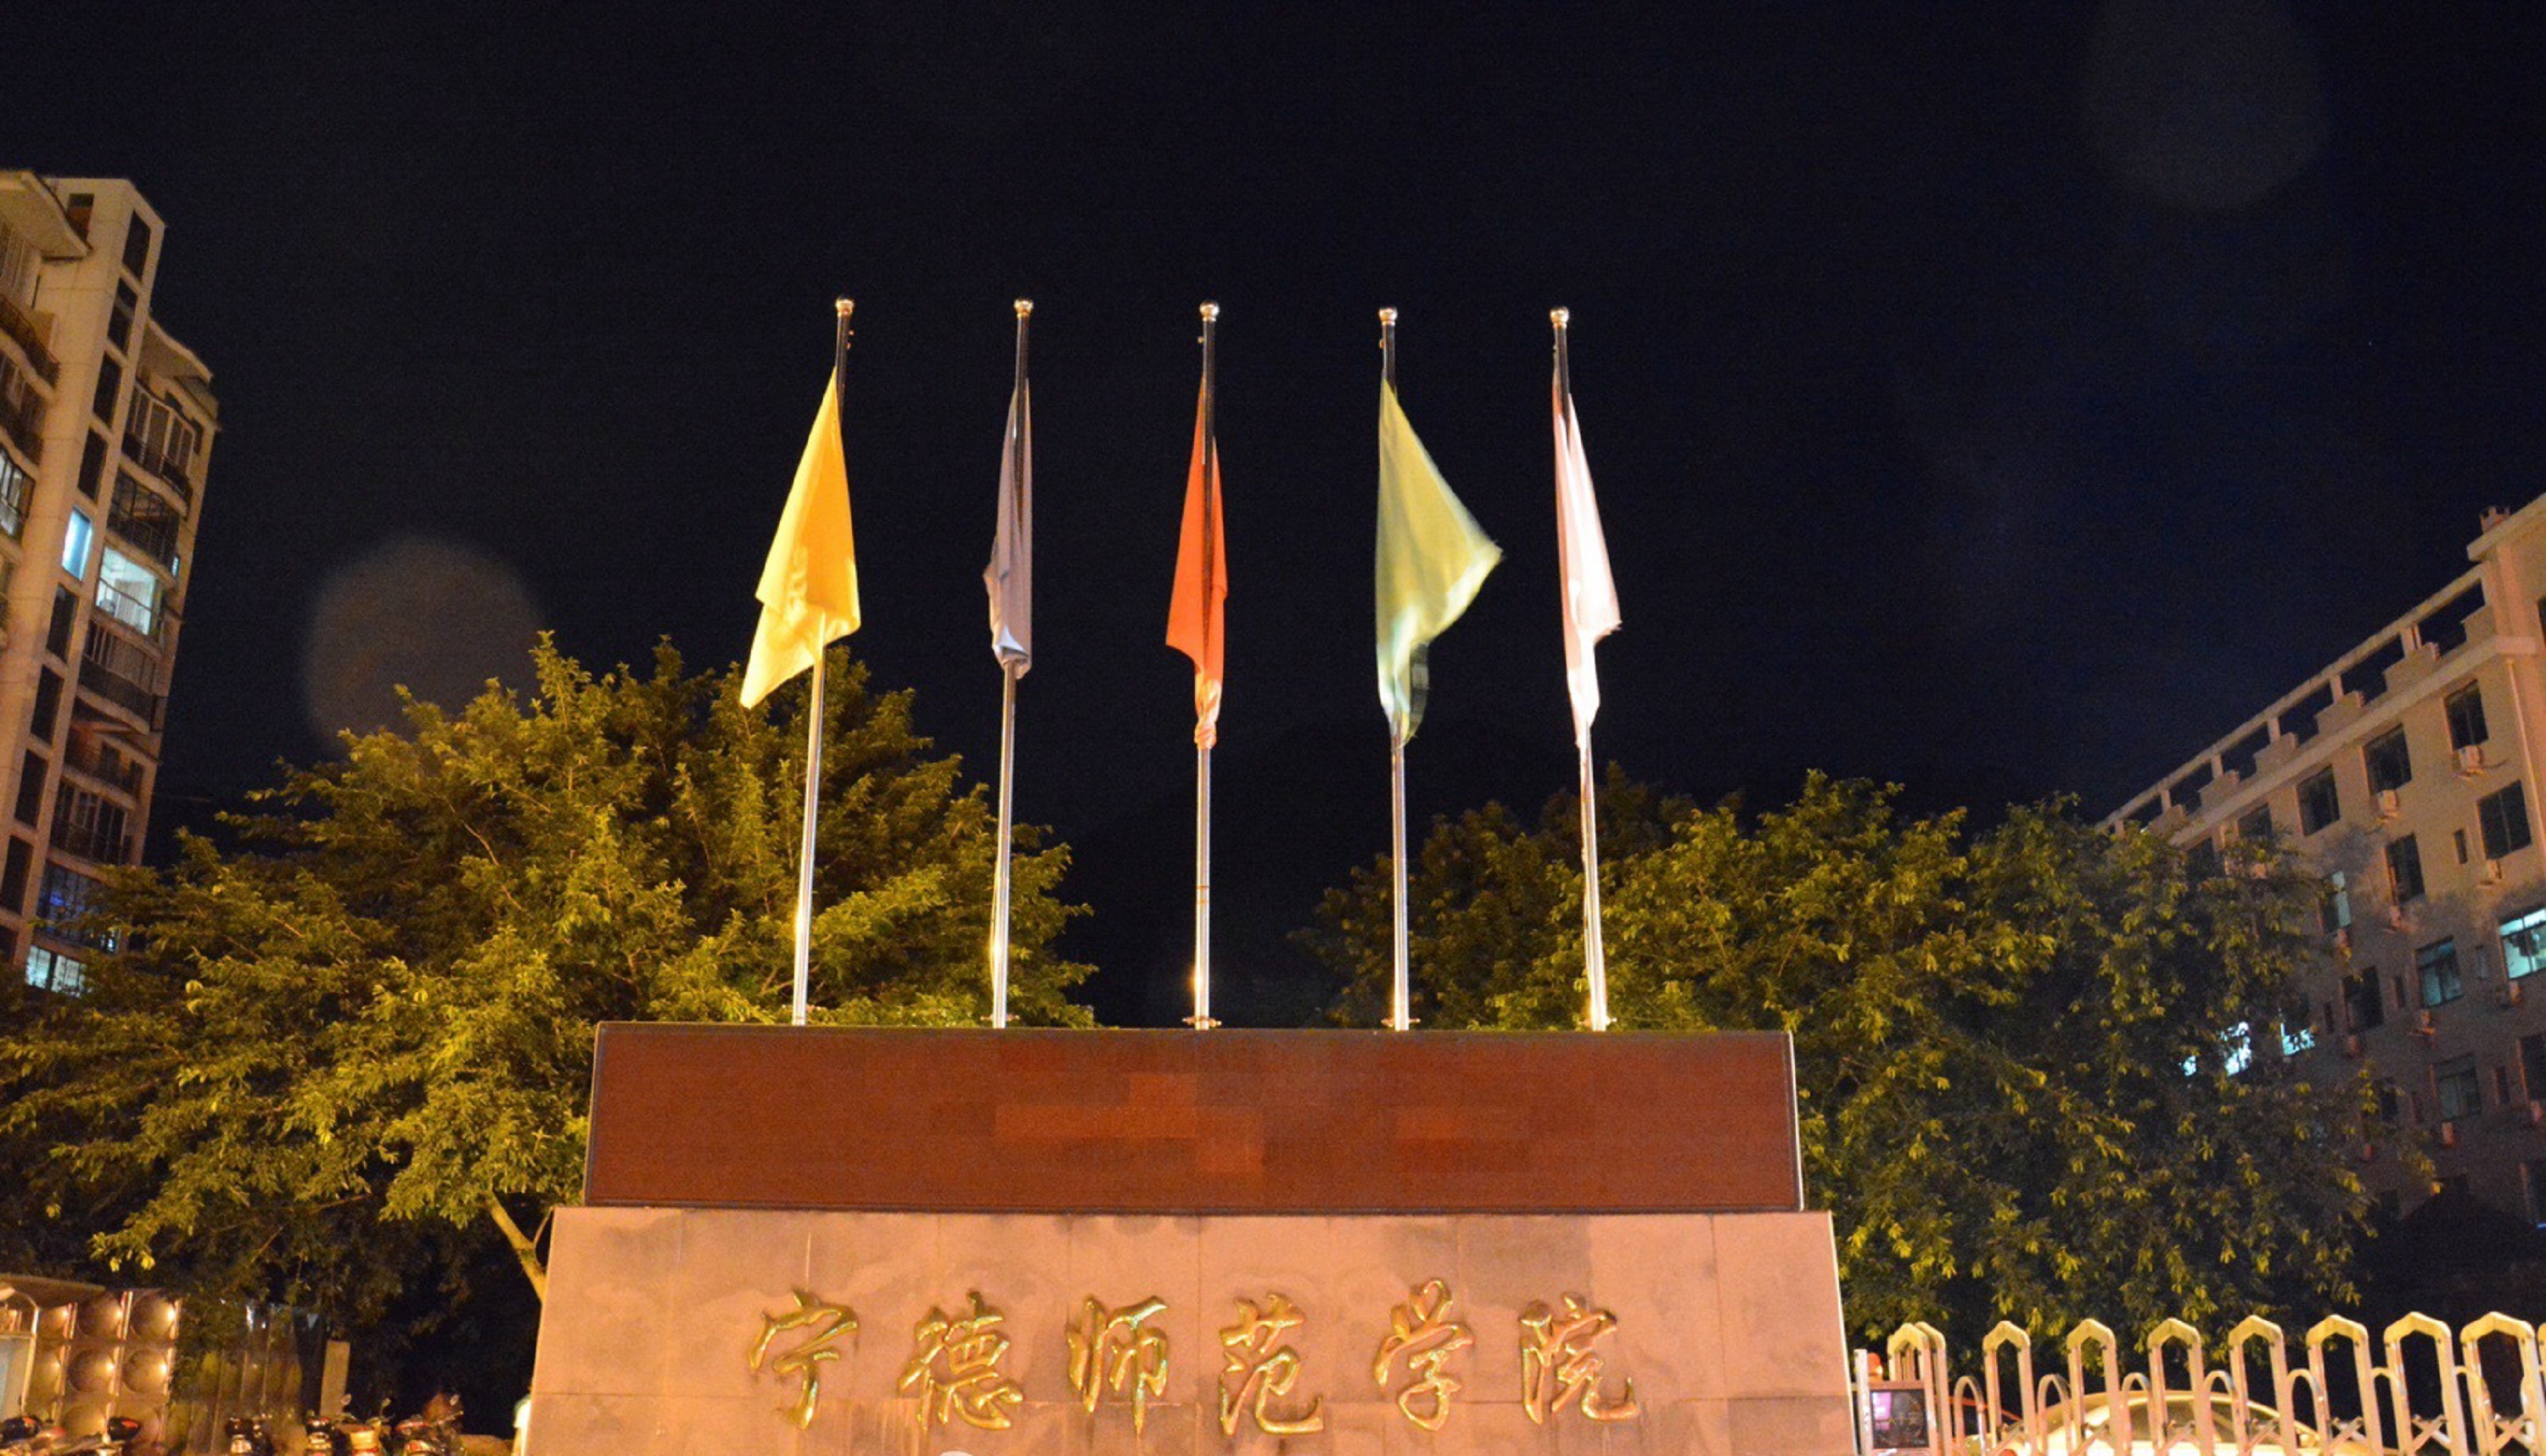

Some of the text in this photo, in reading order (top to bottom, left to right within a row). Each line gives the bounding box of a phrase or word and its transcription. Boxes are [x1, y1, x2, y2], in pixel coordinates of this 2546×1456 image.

[749, 1279, 1640, 1435] 宁德师范学院
